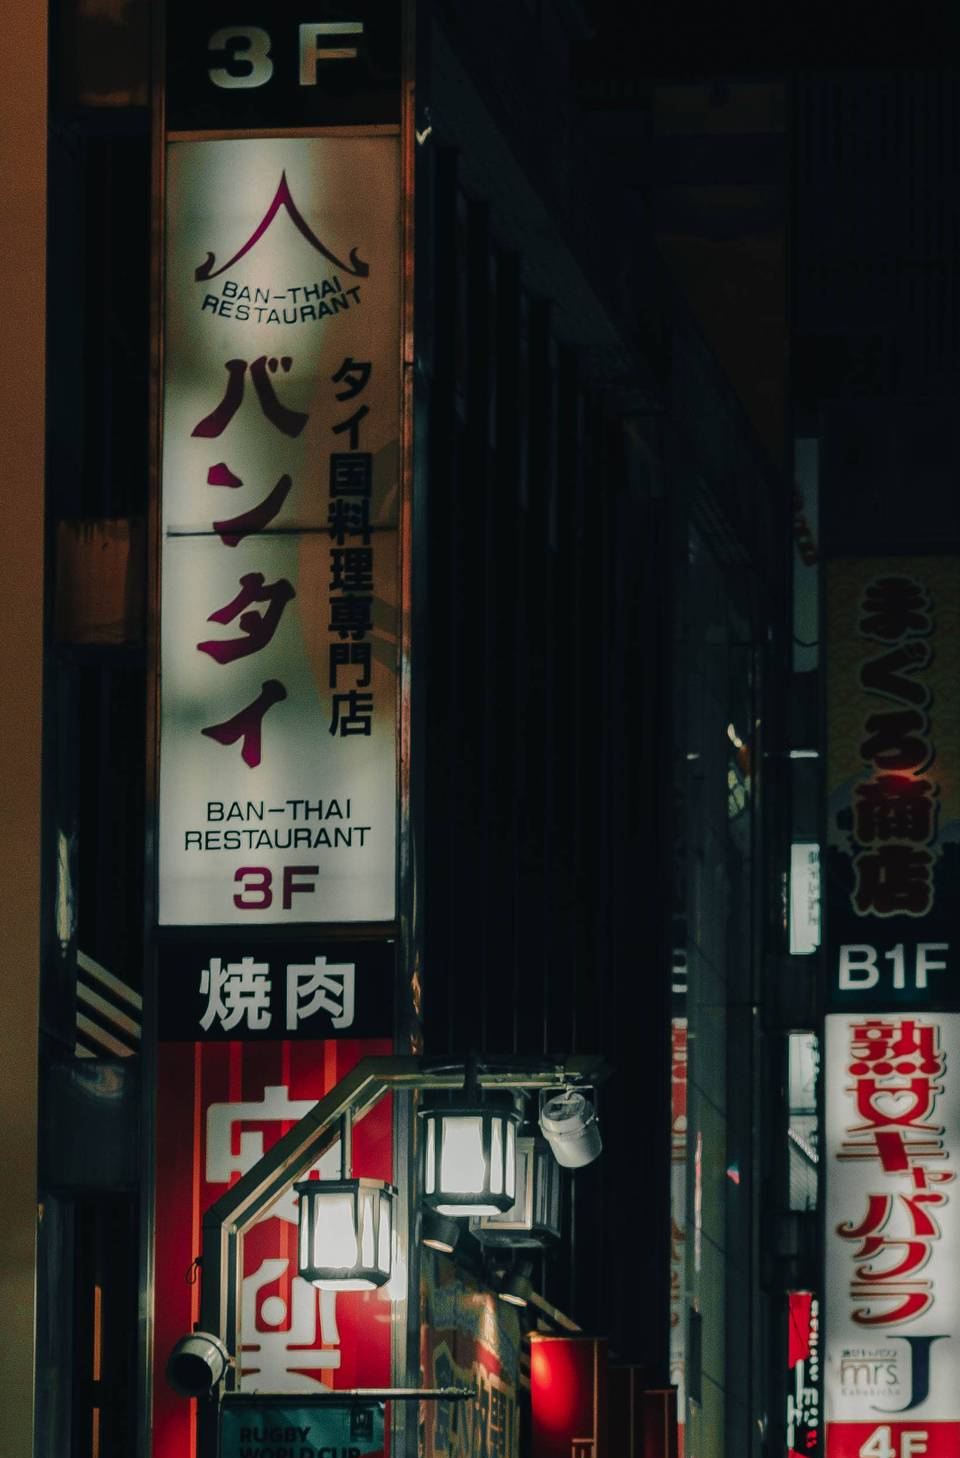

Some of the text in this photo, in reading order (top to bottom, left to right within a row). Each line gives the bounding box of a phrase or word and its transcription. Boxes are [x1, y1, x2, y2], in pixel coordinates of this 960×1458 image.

[208, 22, 364, 88] 3F
[201, 285, 362, 325] RESTAURANT
[222, 274, 343, 305] BAN-THAI
[190, 354, 309, 769] バンタイ
[327, 357, 373, 738] タイ国料理専門店
[206, 799, 352, 822] BAN-THAI
[184, 826, 371, 851] RESTAURANT
[232, 865, 320, 910] 3F
[838, 943, 950, 991] B1F
[198, 956, 356, 1031] 焼肉
[836, 1020, 956, 1327] 熟女キャバクラ
[239, 1426, 312, 1444] RUGBY
